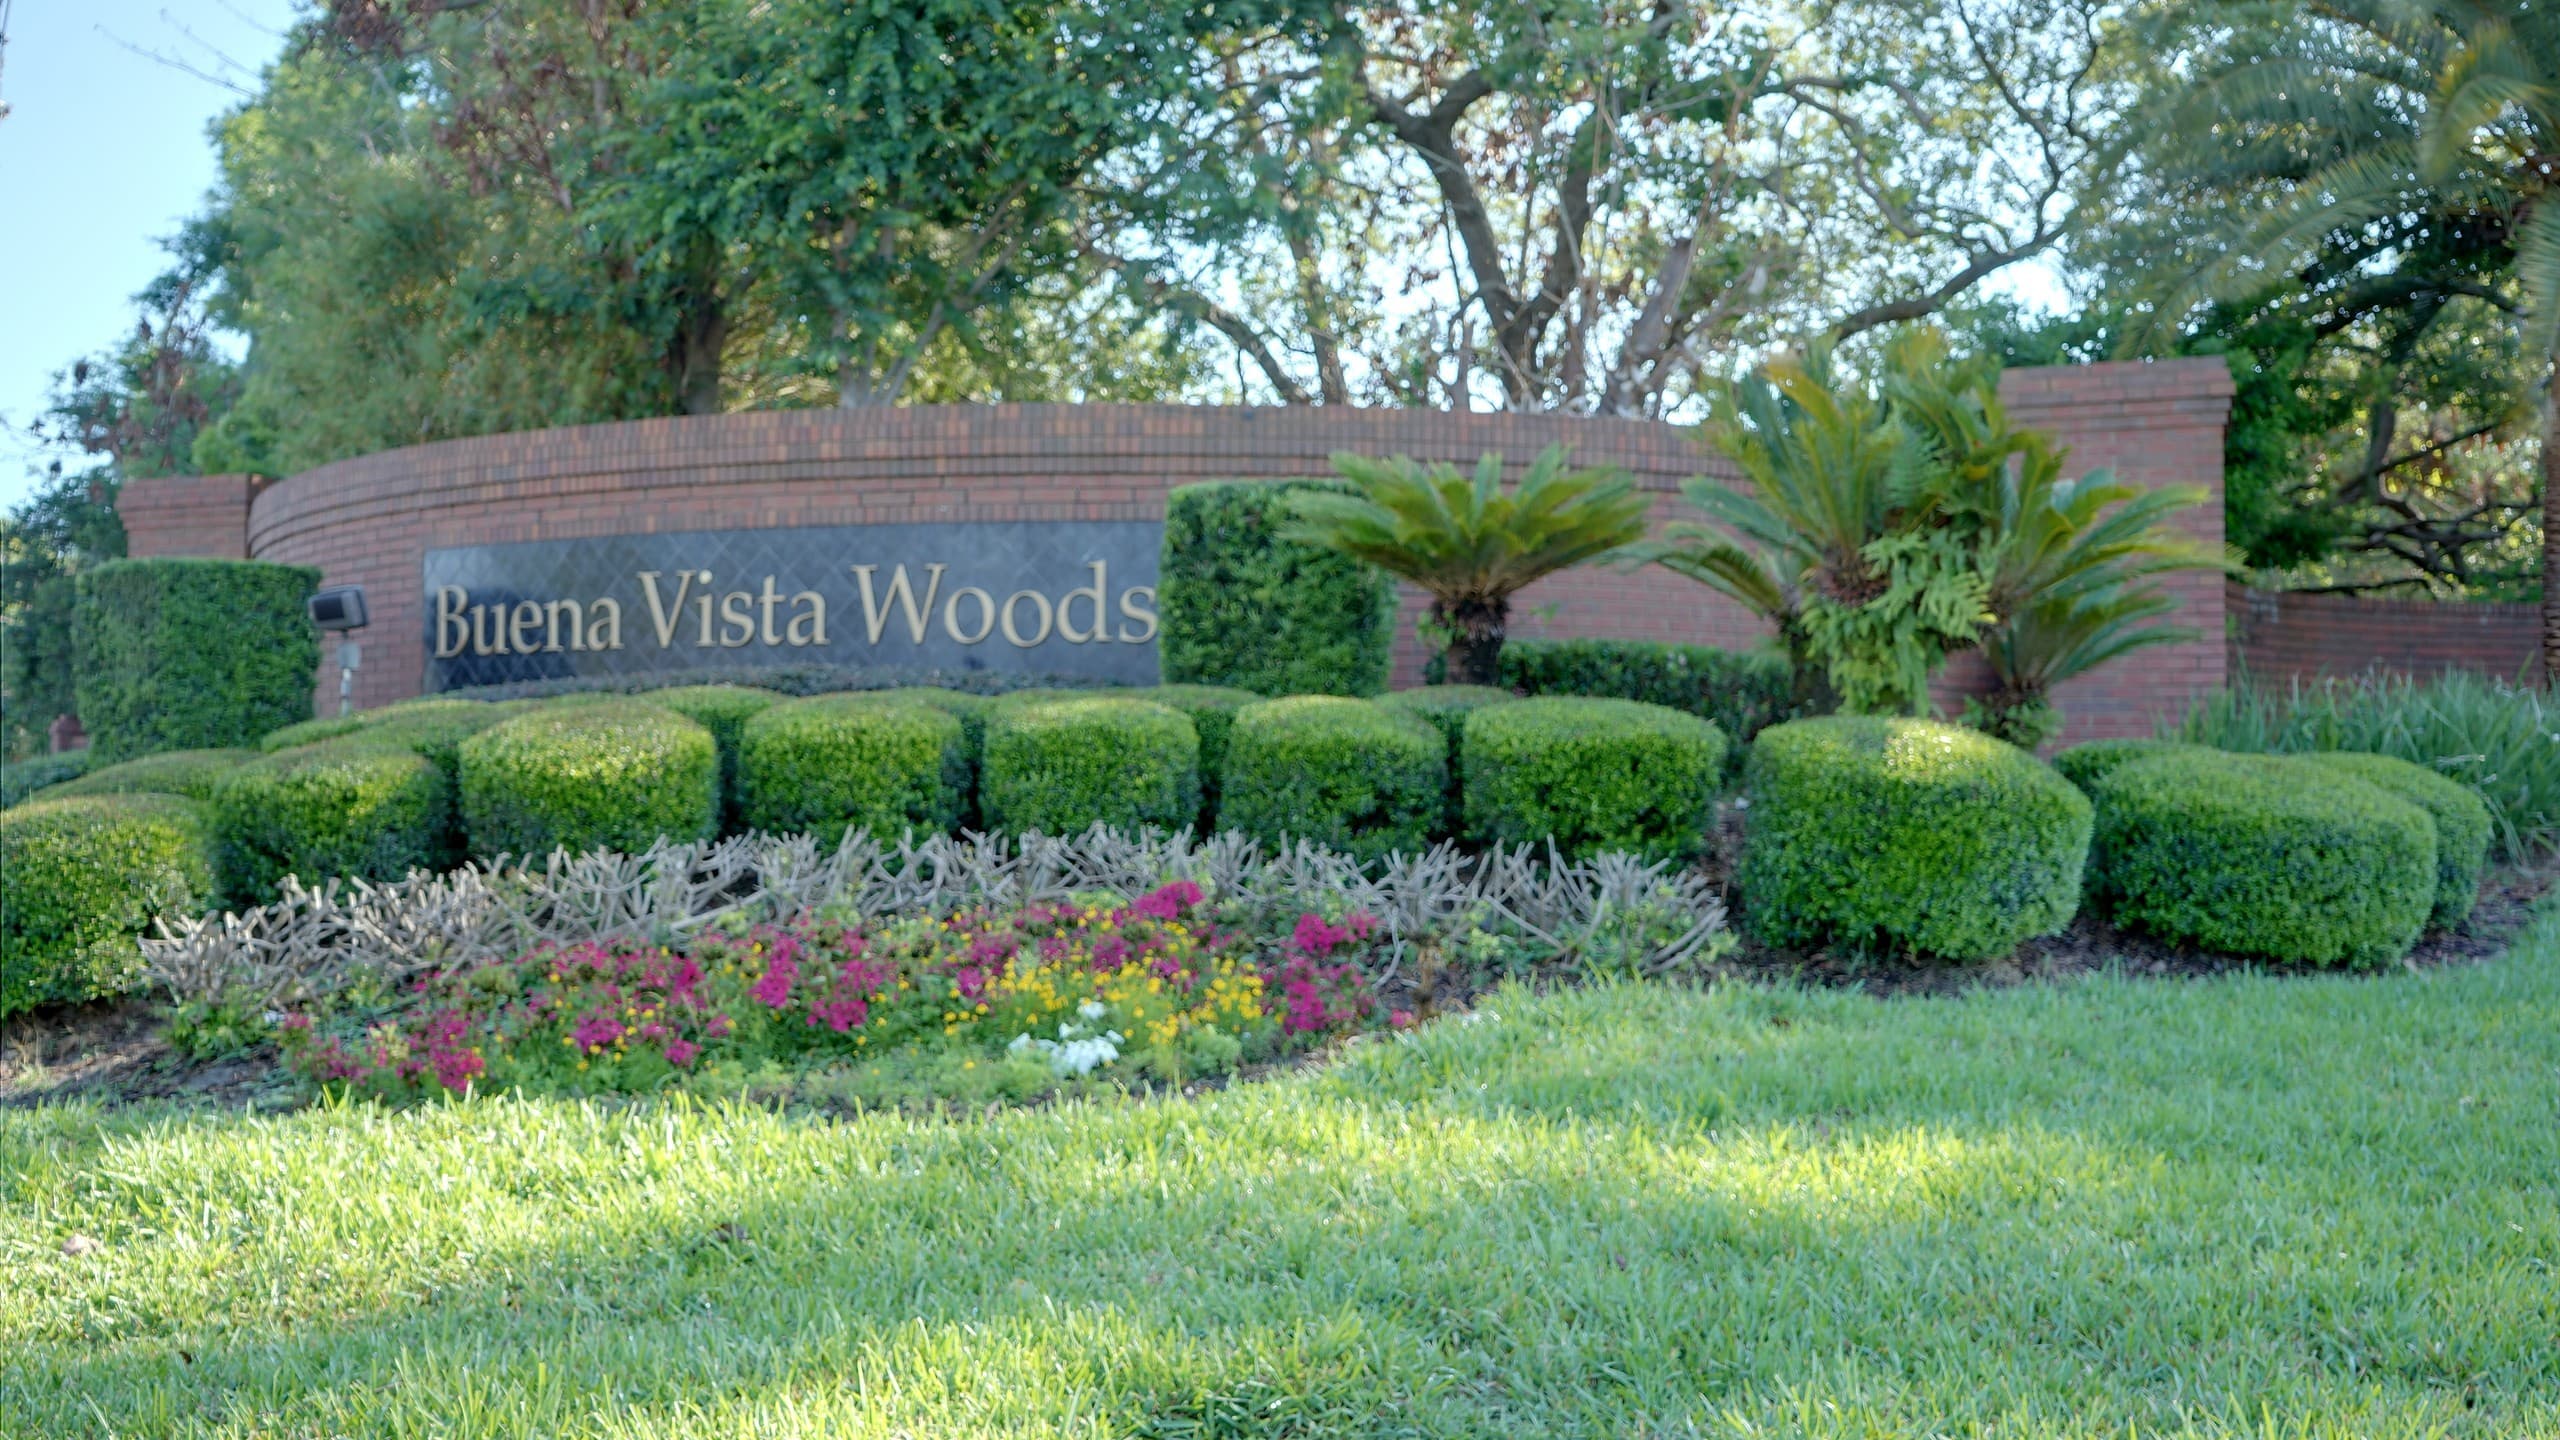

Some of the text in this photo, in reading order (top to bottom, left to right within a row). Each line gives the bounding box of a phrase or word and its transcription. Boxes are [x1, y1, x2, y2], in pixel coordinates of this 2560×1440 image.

[434, 558, 1159, 659] Buena Vista Woods
